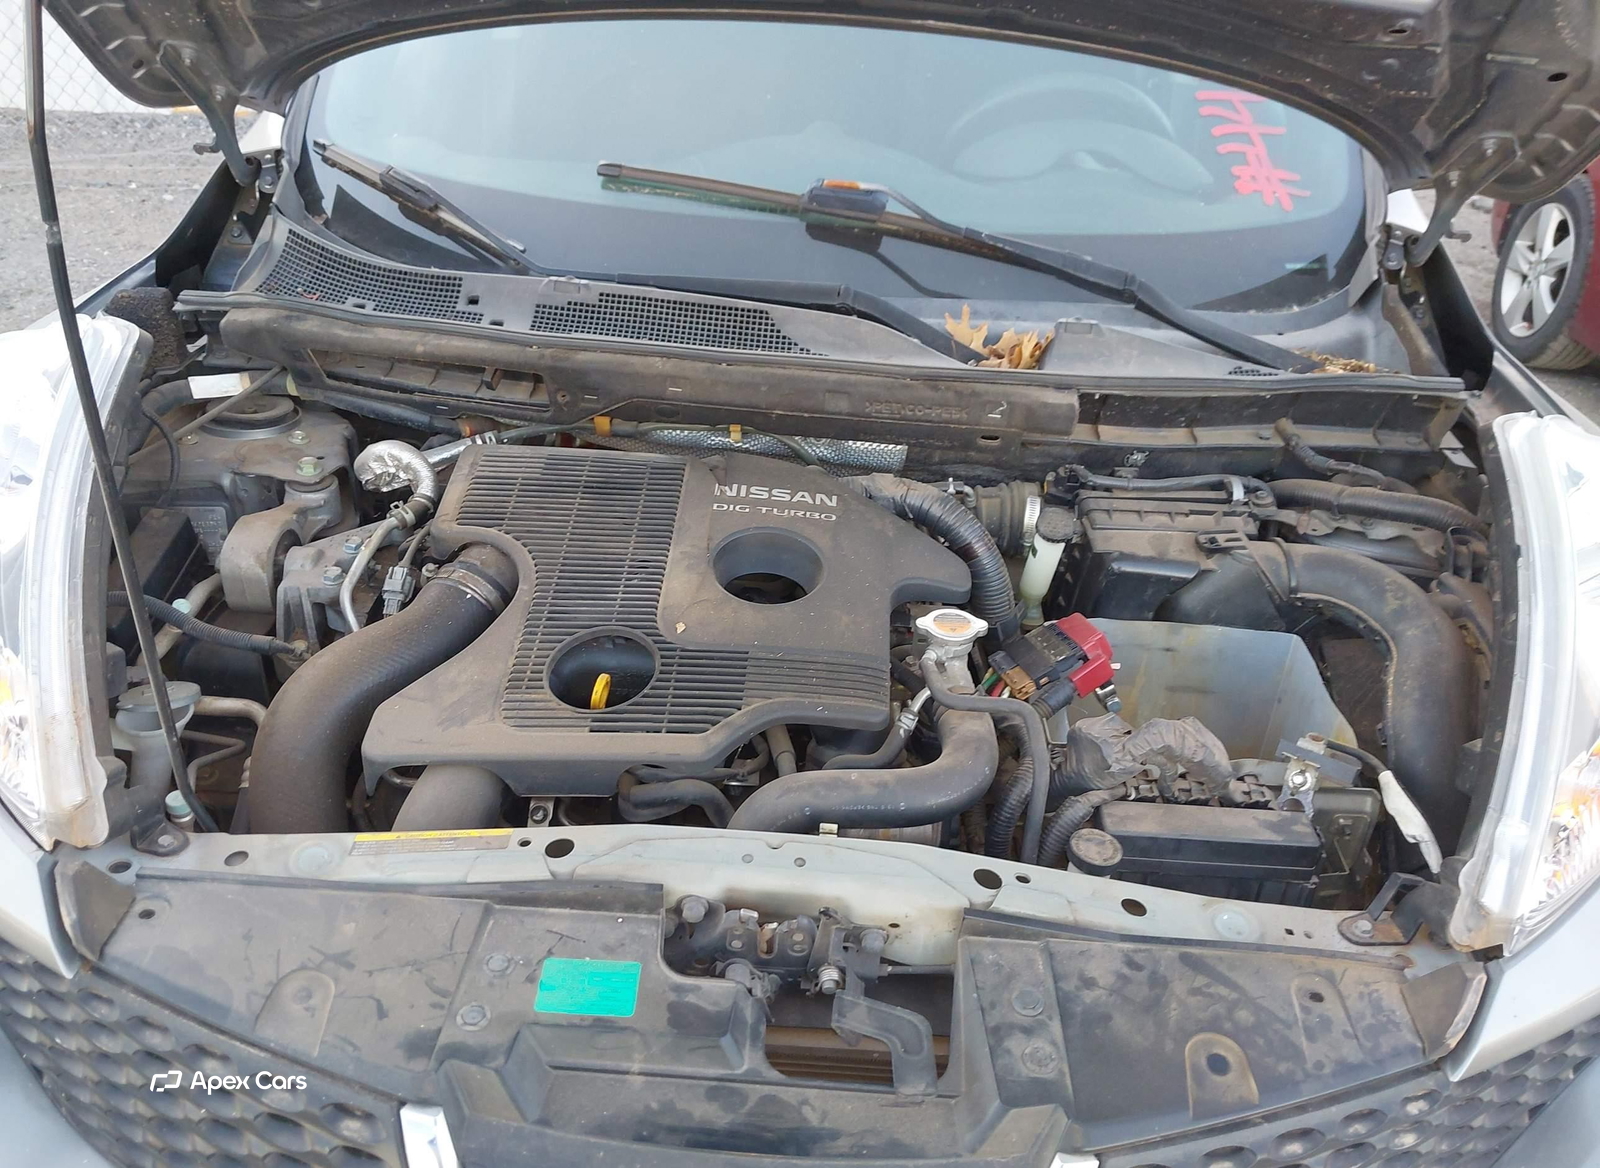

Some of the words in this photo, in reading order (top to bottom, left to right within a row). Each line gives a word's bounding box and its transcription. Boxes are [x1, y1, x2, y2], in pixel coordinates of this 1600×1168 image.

[714, 483, 838, 507] NISSAN
[713, 503, 750, 513] DIG
[756, 506, 837, 521] TURBO
